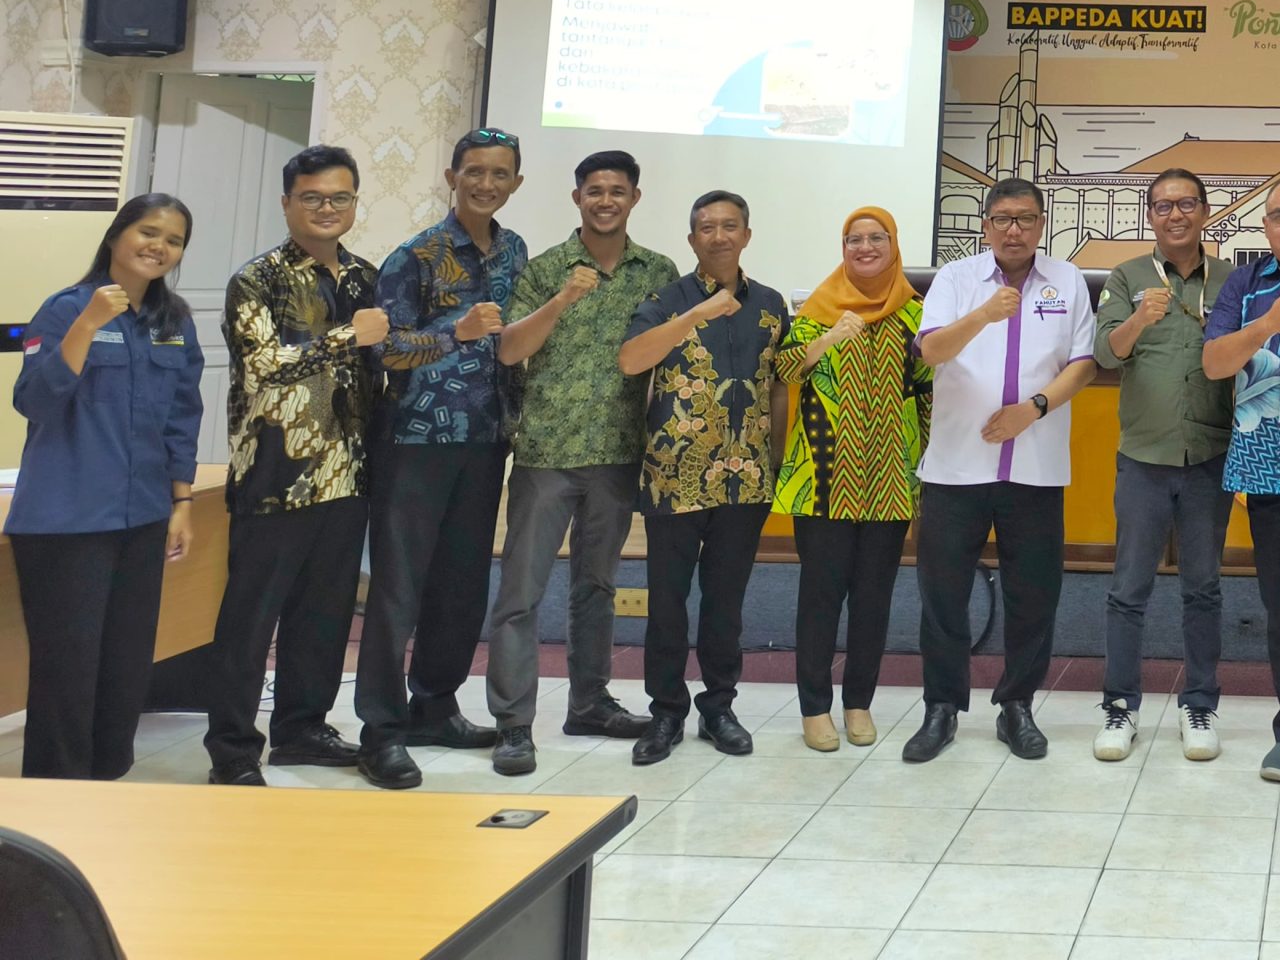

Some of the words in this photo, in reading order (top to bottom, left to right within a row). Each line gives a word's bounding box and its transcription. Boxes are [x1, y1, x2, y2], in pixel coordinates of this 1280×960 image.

[1011, 6, 1123, 27] BAPPEDA
[1131, 8, 1203, 29] KUAT!
[1254, 41, 1277, 49] Kota
